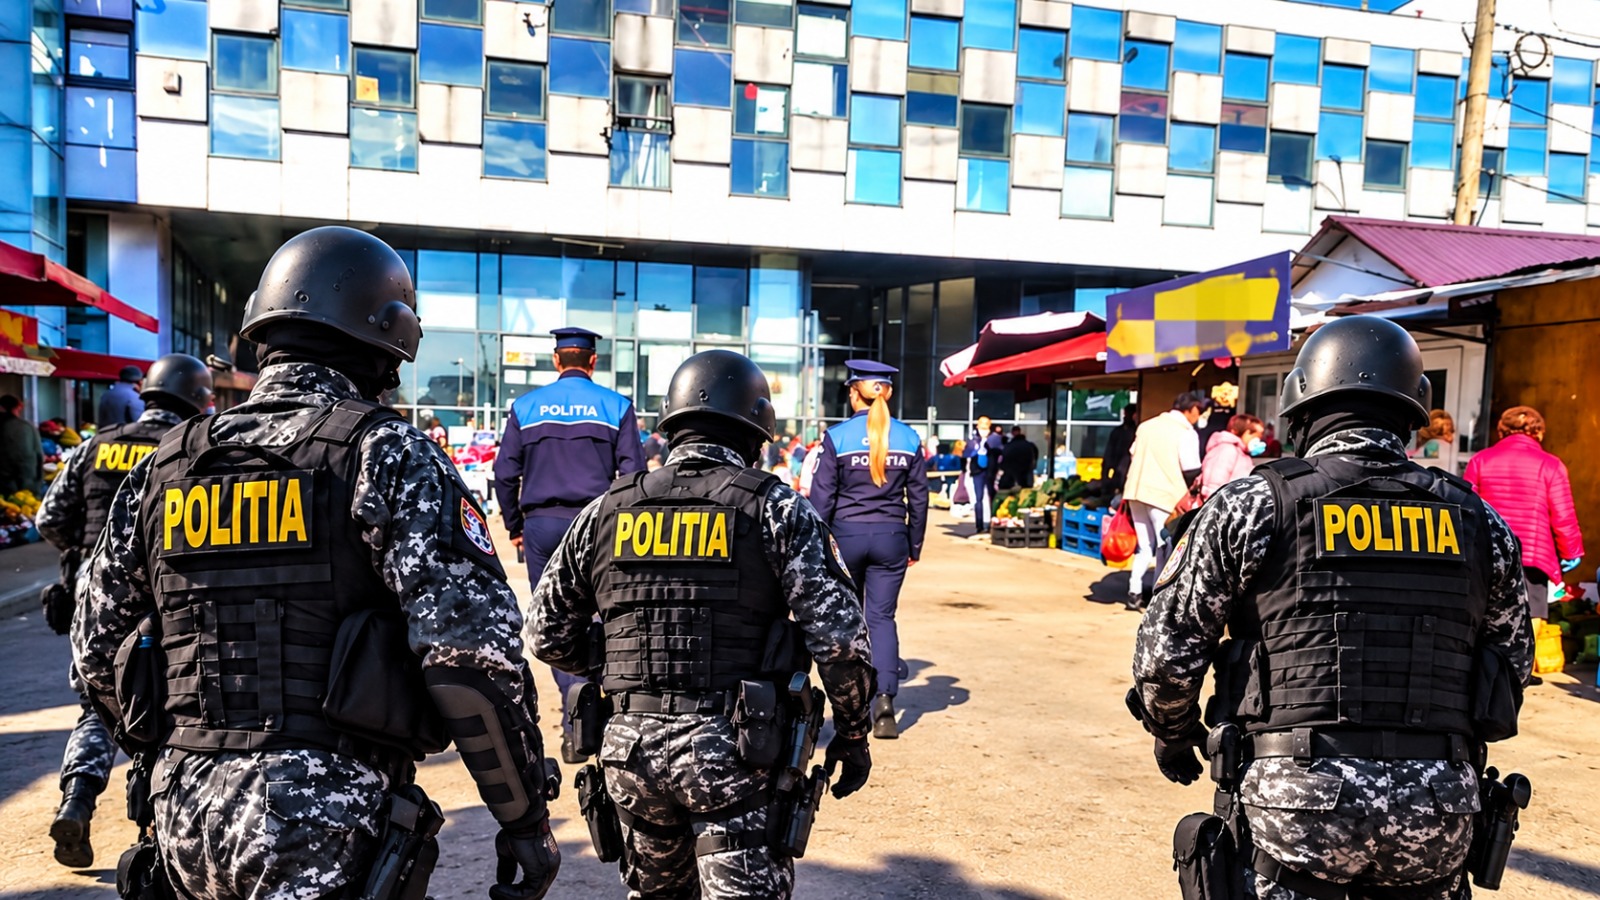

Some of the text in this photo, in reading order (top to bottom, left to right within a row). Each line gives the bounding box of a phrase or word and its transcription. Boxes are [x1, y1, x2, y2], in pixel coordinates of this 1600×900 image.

[540, 404, 598, 417] POLITIA
[95, 443, 158, 470] POLIT
[851, 455, 908, 466] POTIA
[164, 478, 307, 550] POLITIA
[1323, 503, 1460, 555] POLITIA
[614, 511, 728, 557] POLITIA
